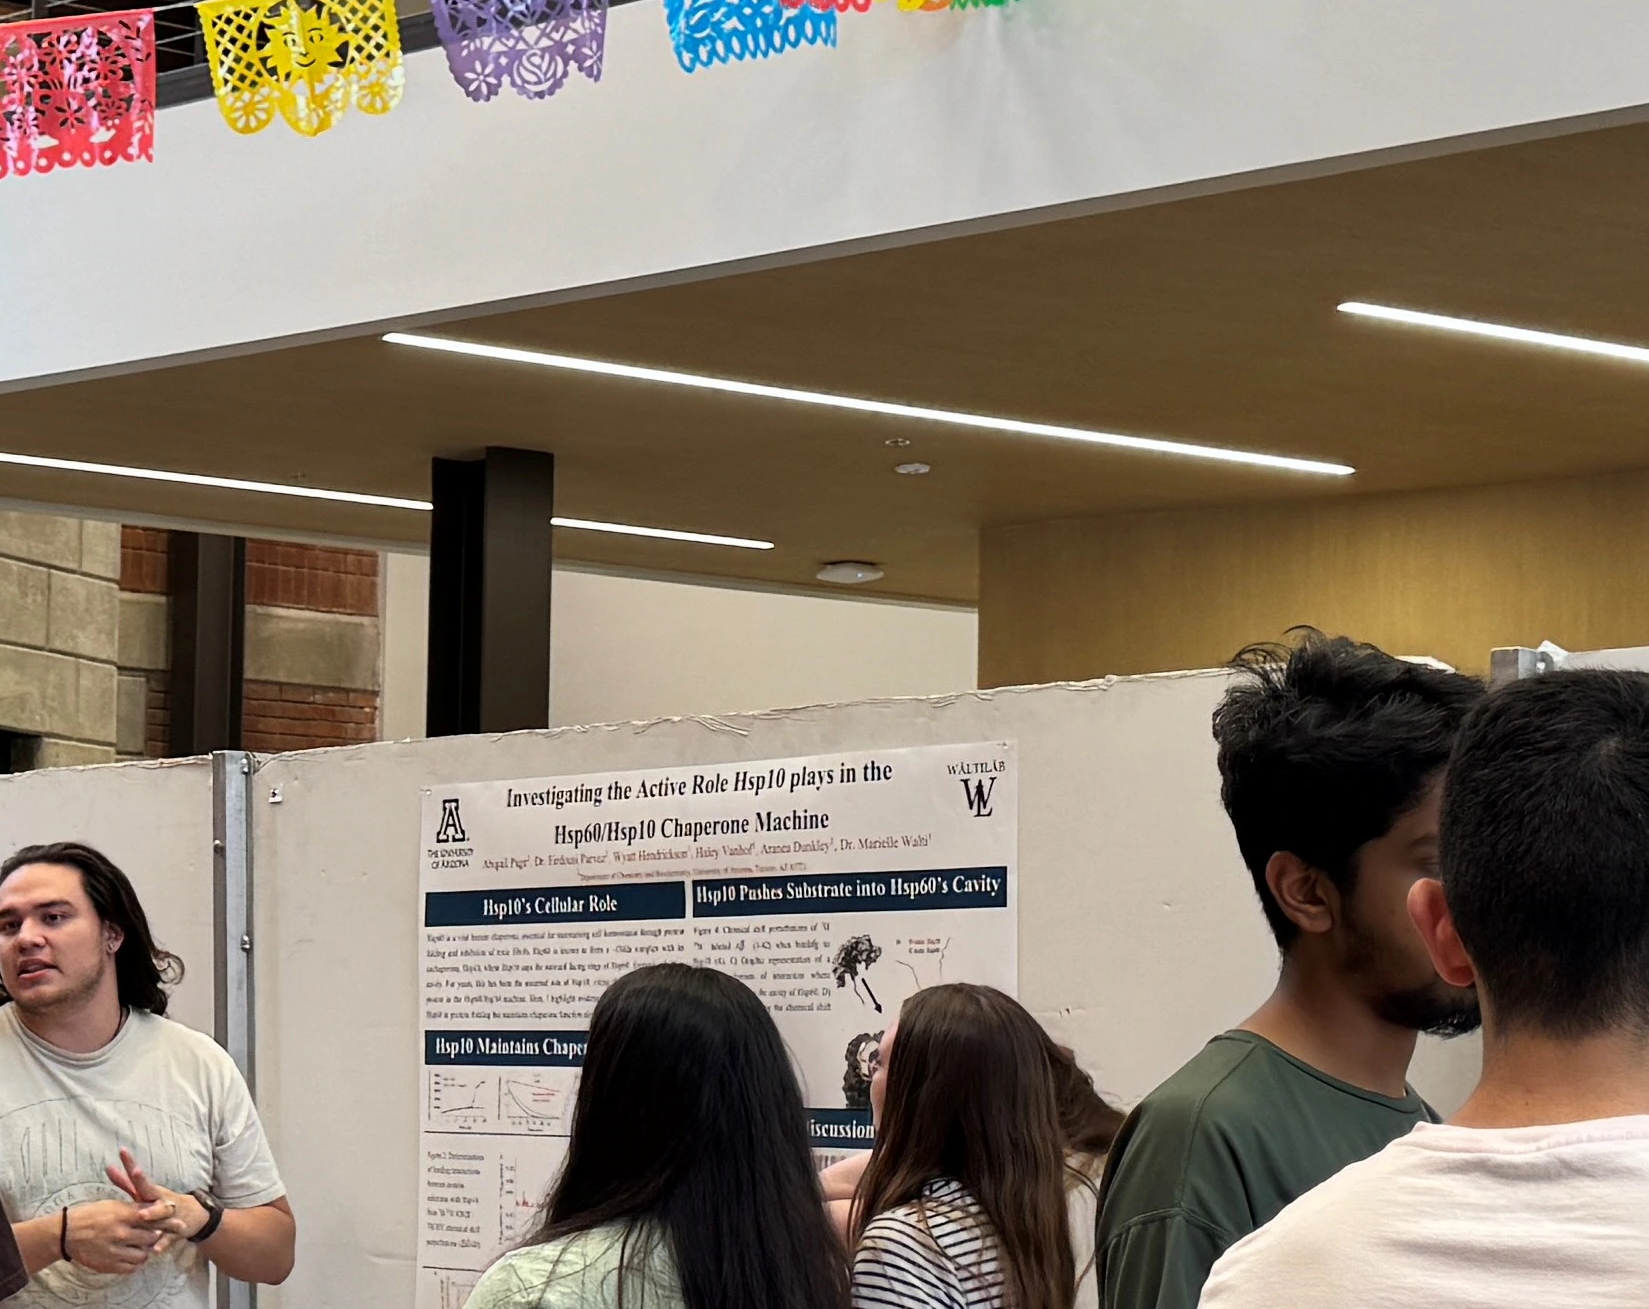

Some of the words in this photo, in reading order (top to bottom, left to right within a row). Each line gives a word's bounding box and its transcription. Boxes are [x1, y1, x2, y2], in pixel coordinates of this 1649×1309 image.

[506, 784, 602, 809] Investigating
[607, 781, 632, 800] the
[636, 777, 686, 798] Active
[692, 773, 728, 794] Role
[733, 768, 786, 795] Hsp10
[789, 766, 834, 793] plays
[839, 764, 856, 783] in
[863, 761, 892, 781] the
[554, 819, 656, 849] Hsp60/Hsp10
[660, 818, 749, 842] Chaperone
[755, 810, 829, 832] Machine
[696, 885, 736, 906] Hsp10
[740, 883, 783, 900] Pushes
[786, 882, 852, 899] Substrate
[856, 880, 885, 896] into
[890, 877, 948, 899] Hsp60's
[952, 874, 1000, 896] Cavity
[483, 898, 531, 920] Hsp10's
[534, 896, 584, 914] Cellular
[589, 894, 617, 911] Role
[436, 1037, 473, 1058] Hsp10
[476, 1037, 539, 1054] Maintains
[542, 1038, 587, 1059] Chaper
[807, 1119, 875, 1139] iscussion
